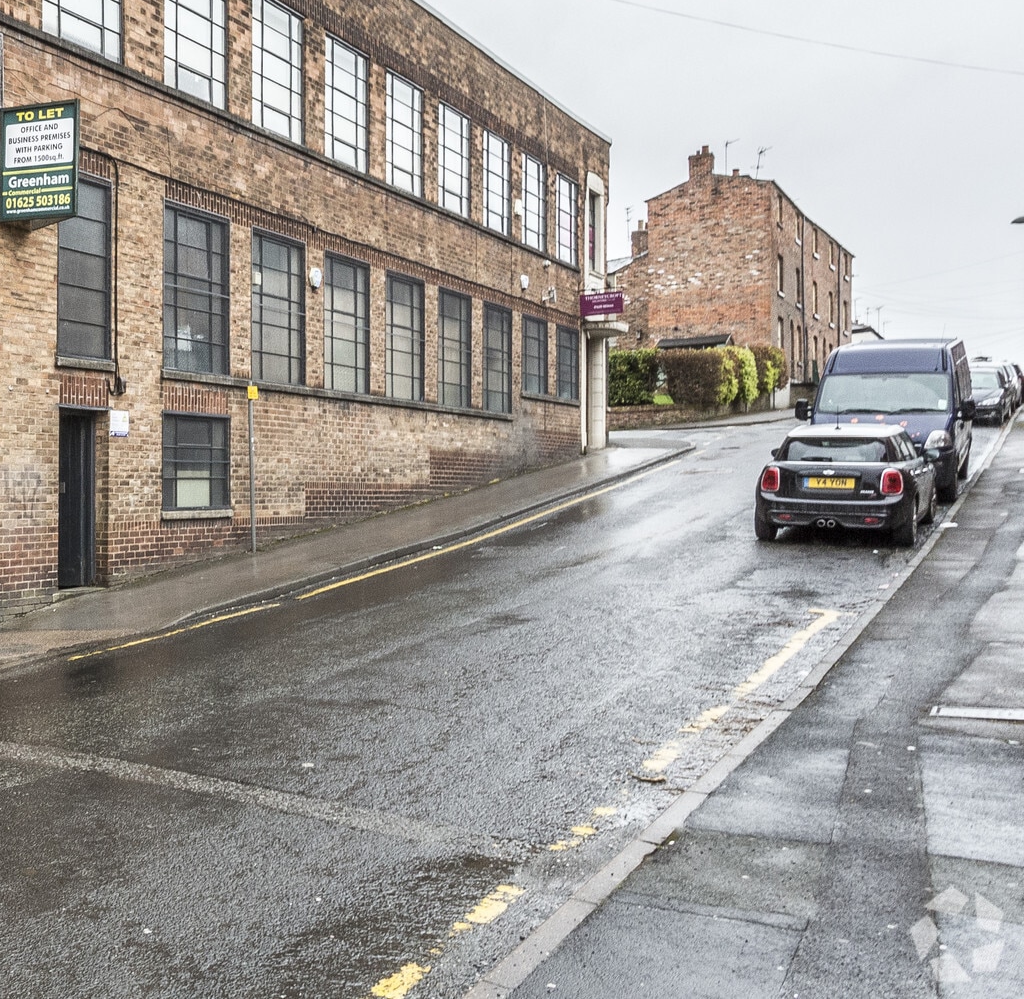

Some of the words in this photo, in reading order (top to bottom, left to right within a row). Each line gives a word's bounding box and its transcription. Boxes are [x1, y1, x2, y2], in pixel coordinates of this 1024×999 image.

[16, 111, 34, 122] TO
[38, 107, 64, 120] LET
[20, 124, 42, 134] OFFICE
[44, 123, 58, 131] AND
[8, 136, 38, 144] BUSINESS
[40, 132, 70, 141] PREMISES
[34, 143, 63, 152] PARKING
[14, 156, 32, 164] FROM
[8, 173, 70, 188] Greenham
[8, 188, 42, 196] Commercial
[6, 196, 34, 209] 01625
[36, 193, 71, 206] 503186
